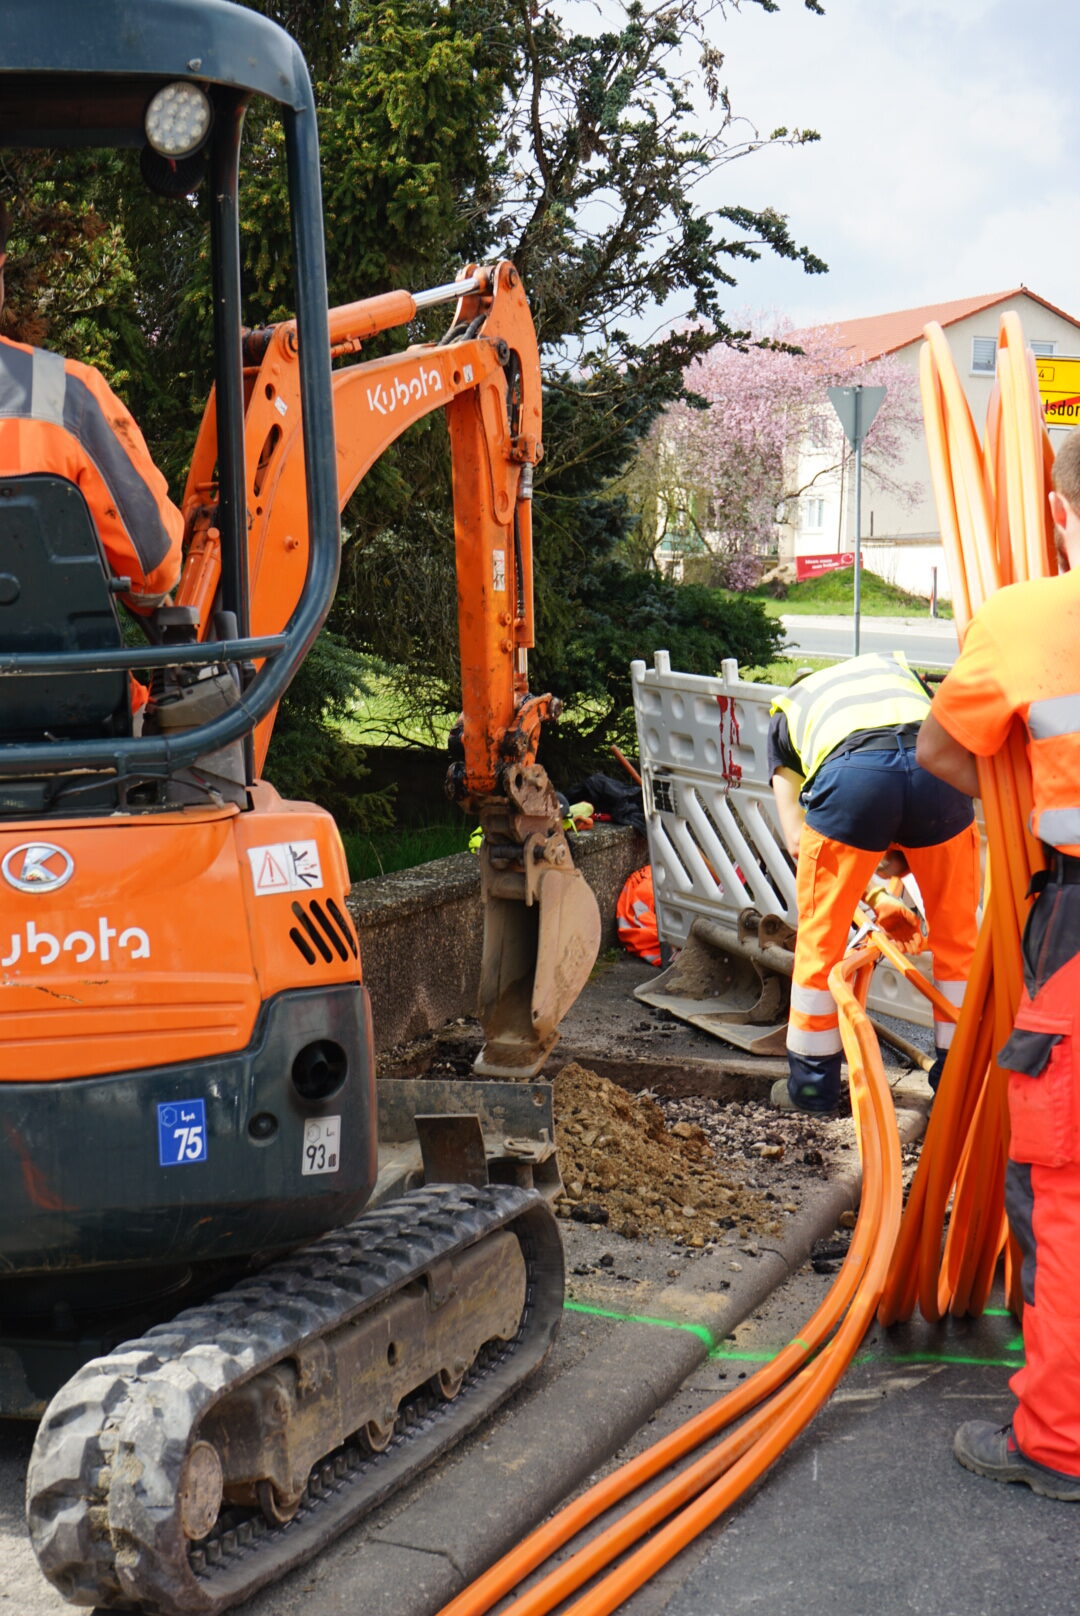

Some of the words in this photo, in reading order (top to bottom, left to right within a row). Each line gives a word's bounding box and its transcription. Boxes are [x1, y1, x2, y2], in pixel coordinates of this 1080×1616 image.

[366, 365, 442, 415] Kubota
[173, 1125, 203, 1161] 75
[306, 1143, 326, 1170] 93
